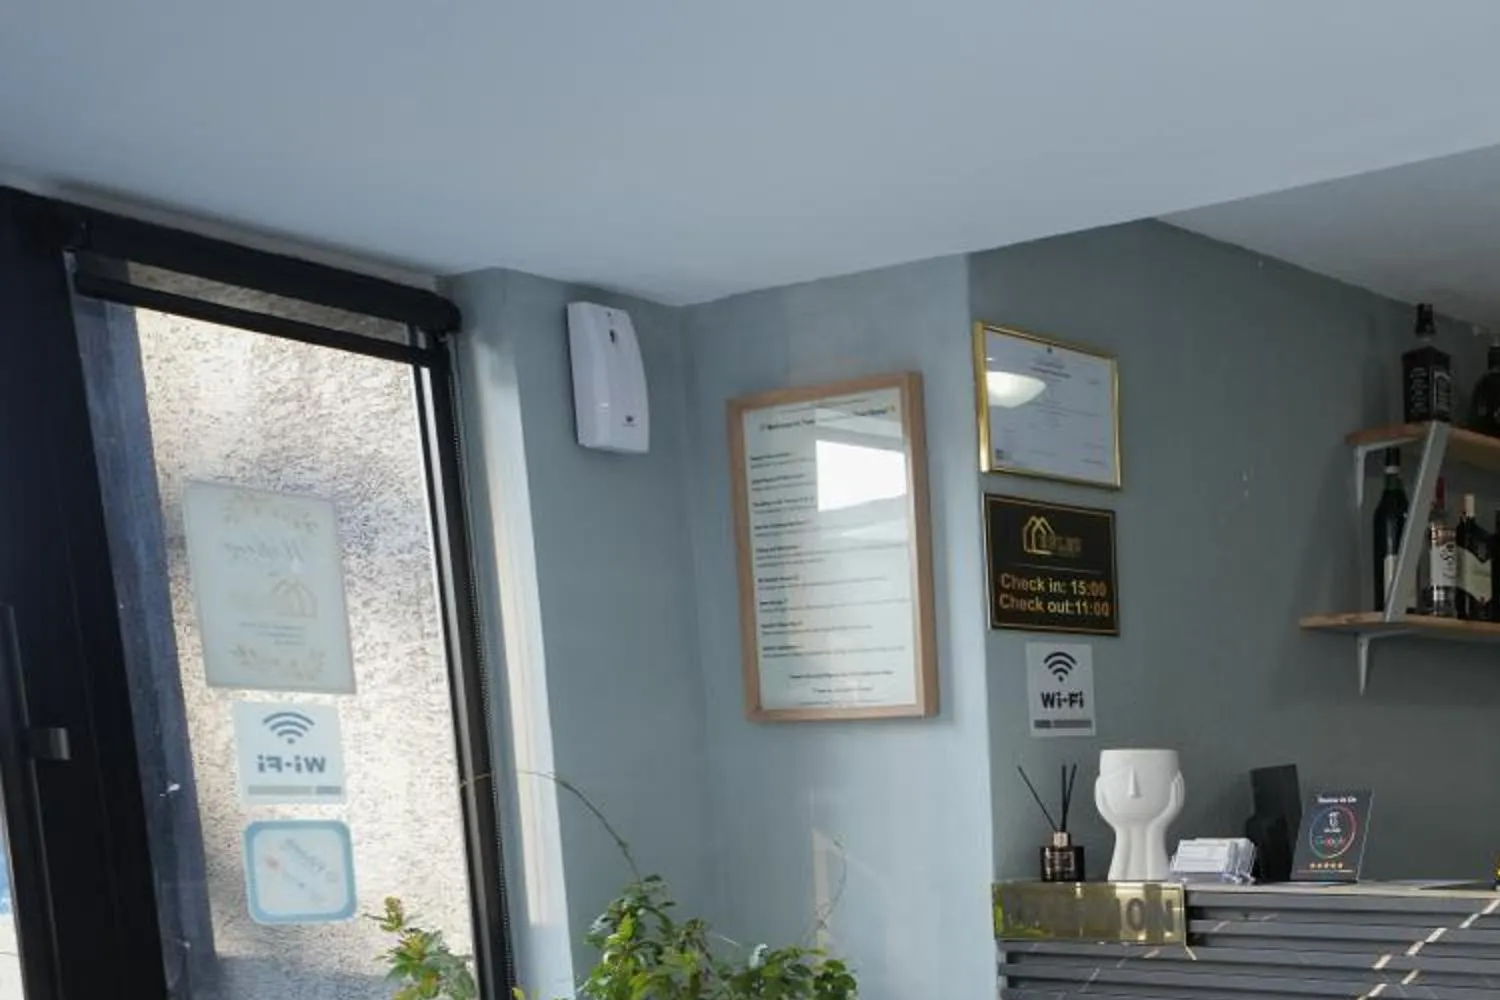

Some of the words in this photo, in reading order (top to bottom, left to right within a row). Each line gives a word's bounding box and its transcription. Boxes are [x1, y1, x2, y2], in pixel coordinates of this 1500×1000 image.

[1001, 572, 1045, 592] Check
[1071, 578, 1107, 598] 15:00
[999, 592, 1045, 613] Check
[1041, 691, 1084, 709] Wi-Fi
